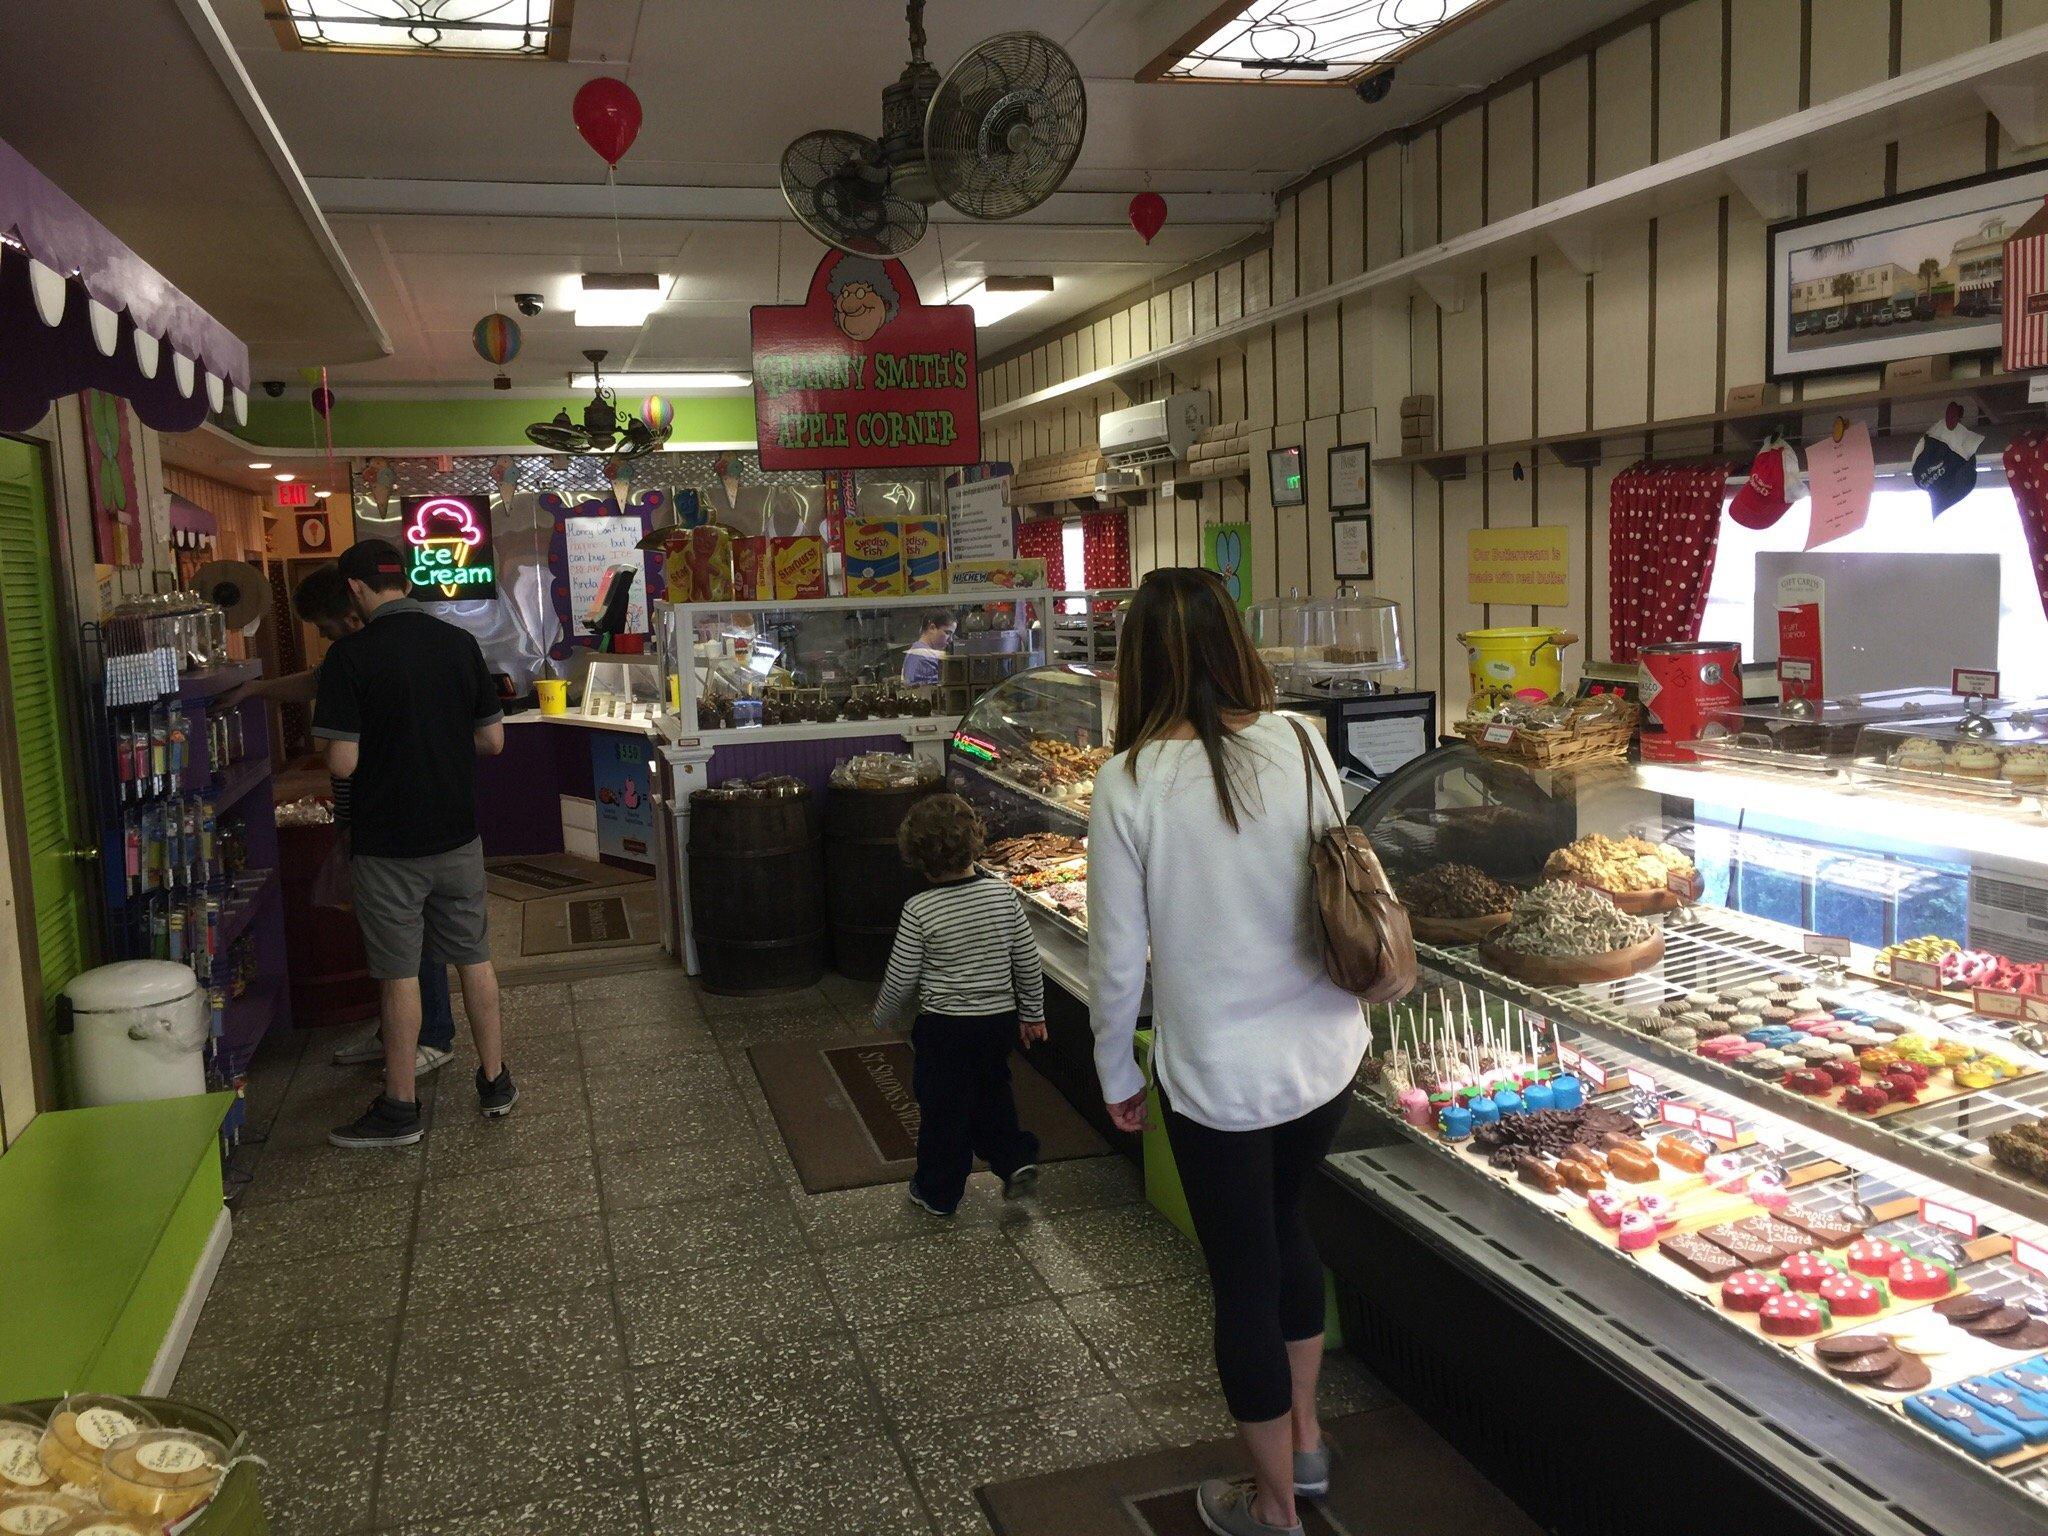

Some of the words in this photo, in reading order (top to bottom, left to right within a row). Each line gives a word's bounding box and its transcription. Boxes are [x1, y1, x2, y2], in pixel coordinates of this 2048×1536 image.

[875, 349, 968, 391] SMITH'S
[778, 411, 849, 449] APPLE
[856, 410, 958, 447] CORNER
[279, 484, 309, 505] EXIT
[854, 535, 890, 551] Swedish
[905, 536, 928, 547] edish
[413, 546, 452, 566] Ice
[864, 546, 884, 556] Fish
[906, 545, 921, 555] ish
[778, 547, 818, 578] Starburst
[410, 563, 493, 587] Cream
[1783, 1206, 1835, 1221] Simons
[1711, 1226, 1759, 1242] Simons
[1742, 1218, 1798, 1234] Simons
[1808, 1220, 1852, 1232] Island
[1767, 1227, 1813, 1245] Island
[1669, 1237, 1721, 1254] Simons
[1729, 1239, 1774, 1254] Island
[1687, 1251, 1737, 1267] Island
